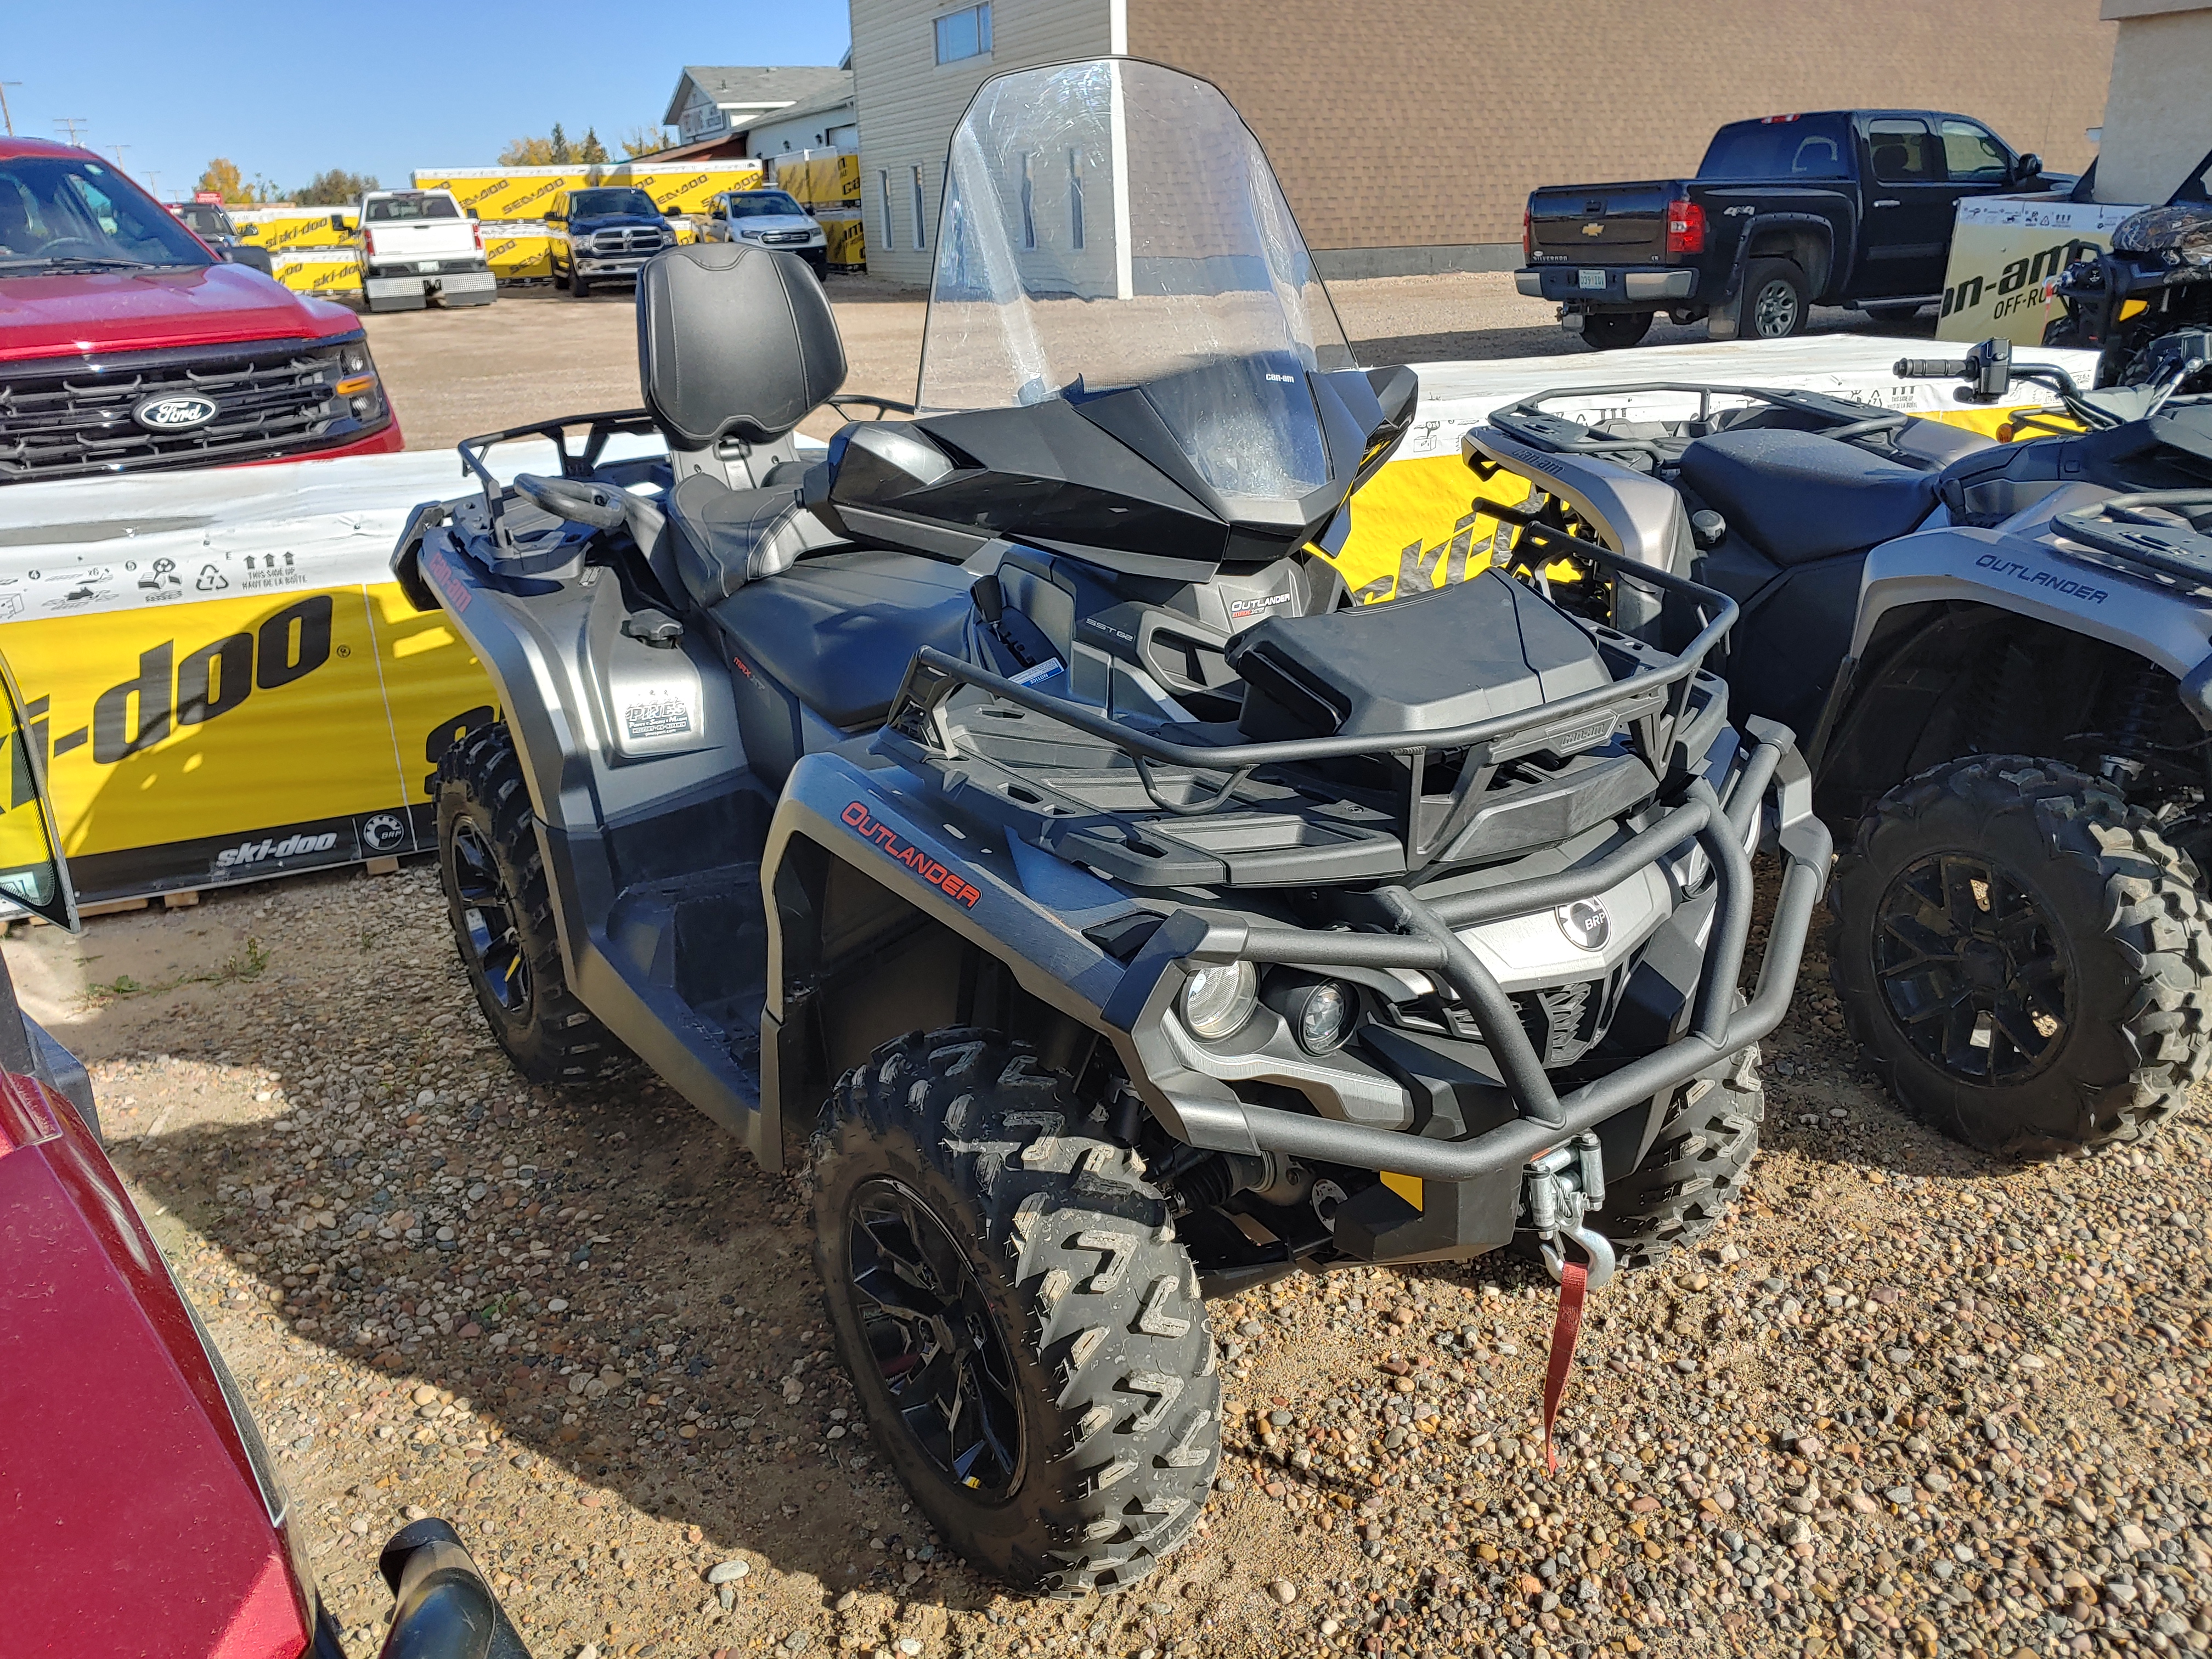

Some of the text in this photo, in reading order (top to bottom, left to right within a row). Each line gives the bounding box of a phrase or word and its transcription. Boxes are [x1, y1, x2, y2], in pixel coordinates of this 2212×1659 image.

[657, 174, 710, 205] EA-DOO
[1265, 373, 1295, 383] can-am
[156, 402, 202, 423] Ford
[1975, 554, 2109, 605] OUTLANDER
[1231, 594, 1291, 612] OUTLANDER
[1085, 618, 1117, 633] SST
[216, 832, 338, 867] ski-doo
[841, 802, 982, 910] OUTLANDER
[1584, 912, 1605, 931] BRP
